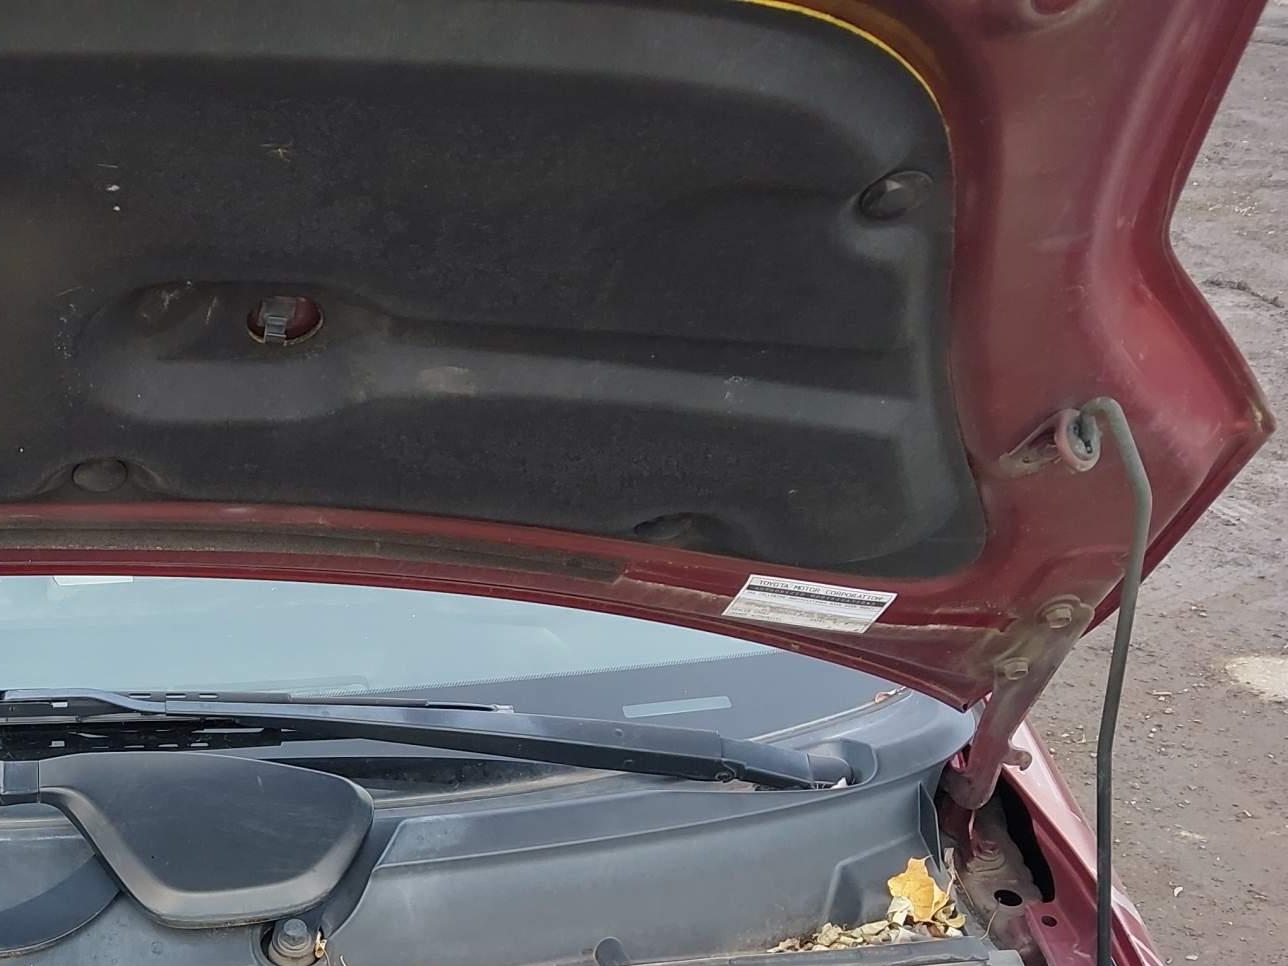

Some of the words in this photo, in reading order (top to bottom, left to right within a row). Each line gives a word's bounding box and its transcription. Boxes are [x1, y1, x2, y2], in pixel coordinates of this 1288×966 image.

[760, 580, 789, 588] TOYOTA
[793, 584, 821, 593] MOTOR
[825, 589, 884, 601] CORPORATION
